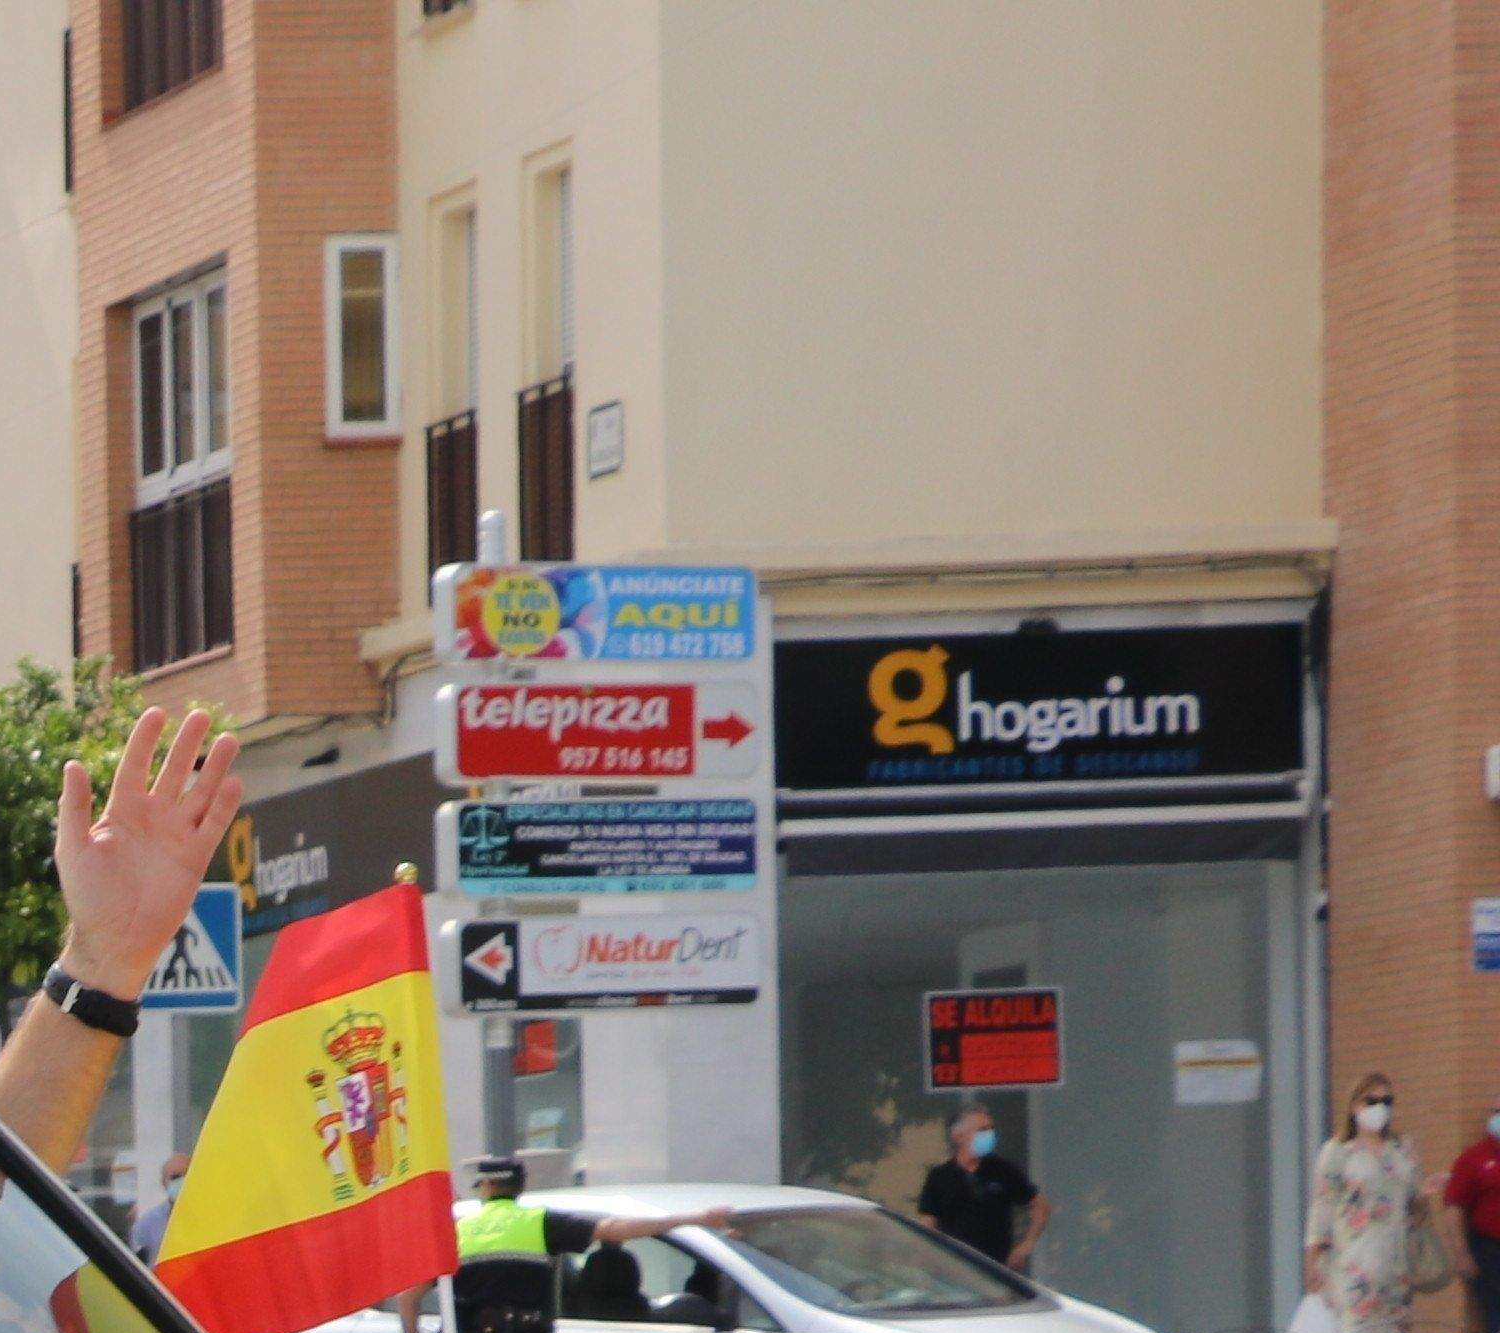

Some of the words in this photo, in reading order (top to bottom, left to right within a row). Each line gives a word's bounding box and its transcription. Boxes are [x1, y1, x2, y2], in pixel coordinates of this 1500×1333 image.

[463, 687, 670, 743] telepizza
[957, 671, 1200, 752] hogarium
[963, 995, 1058, 1028] ALQUILA
